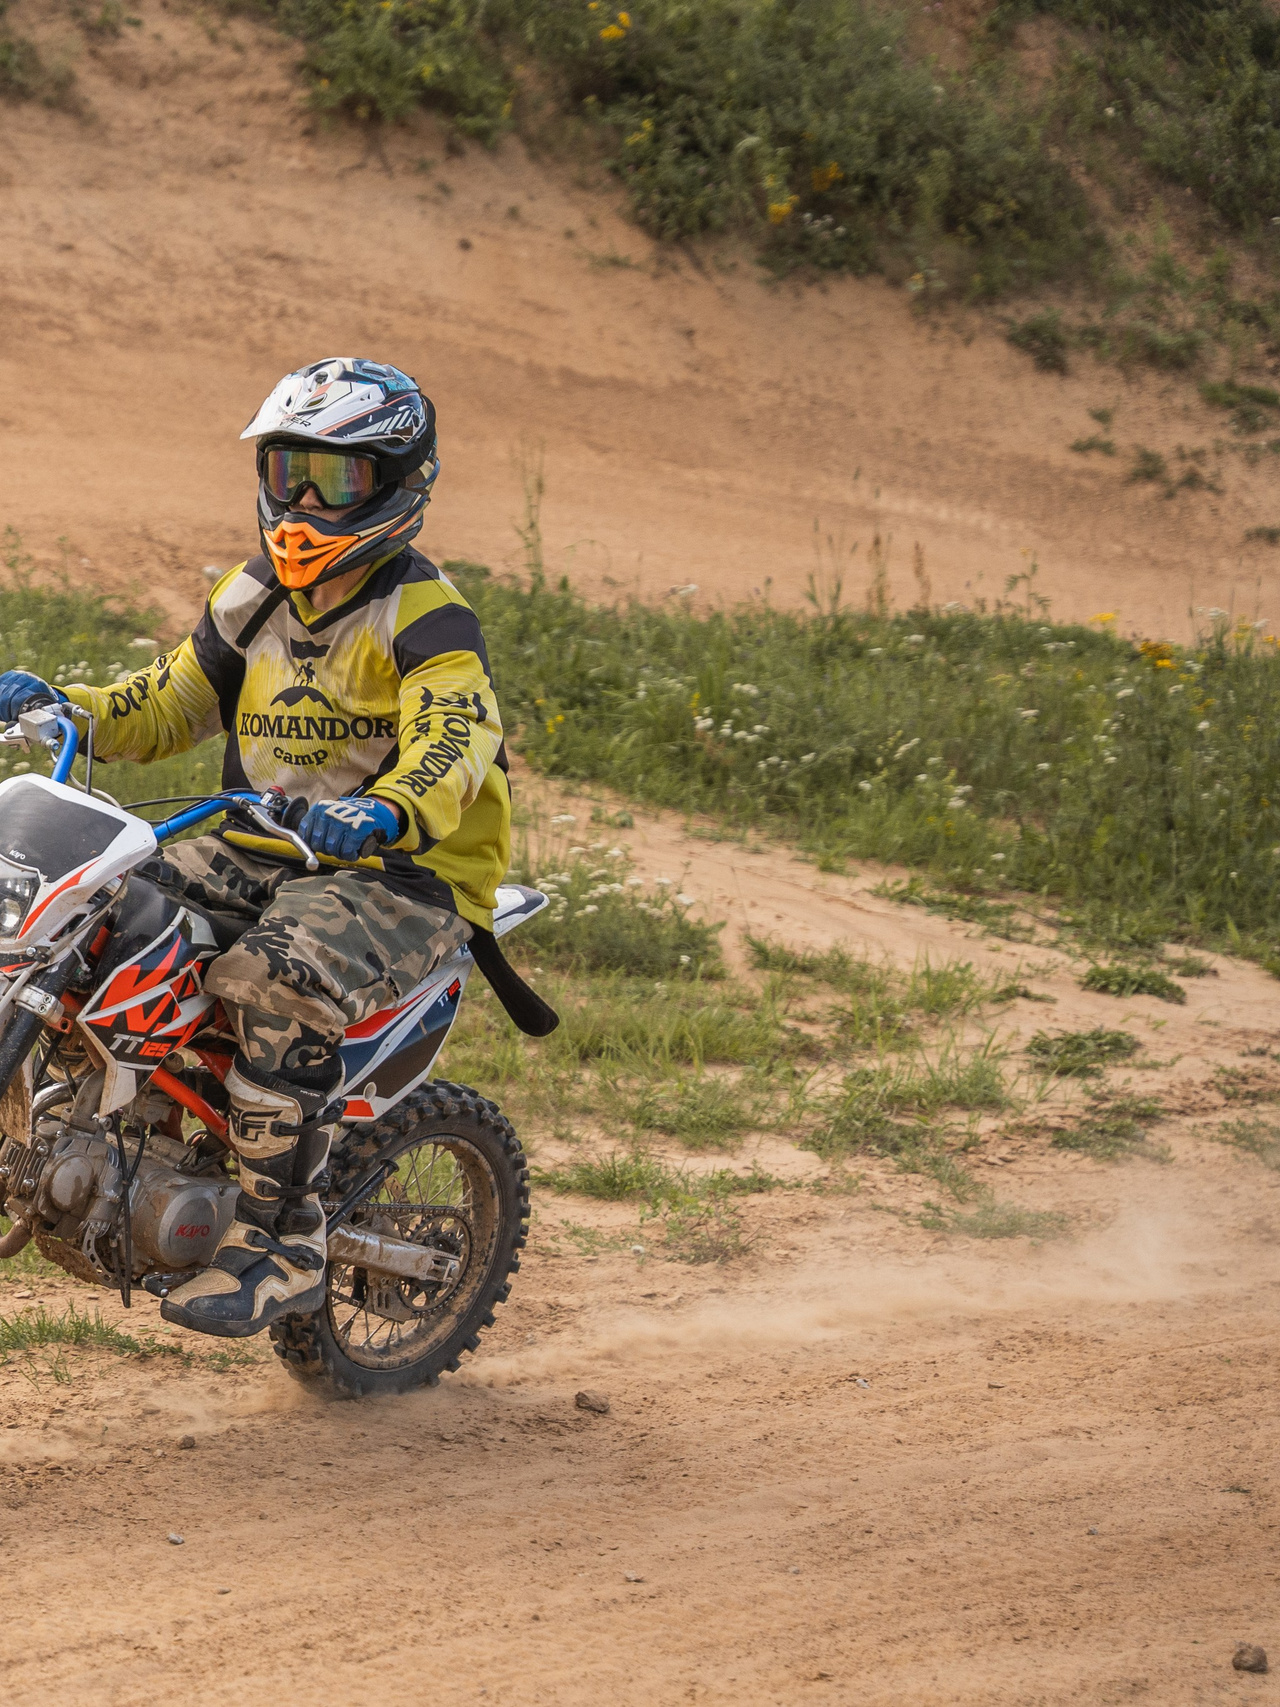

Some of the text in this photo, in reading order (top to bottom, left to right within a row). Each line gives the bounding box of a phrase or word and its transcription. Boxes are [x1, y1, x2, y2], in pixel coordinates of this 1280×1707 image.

[238, 712, 397, 741] KOMANDOR
[272, 746, 329, 766] camp
[395, 715, 471, 798] OMNDOR
